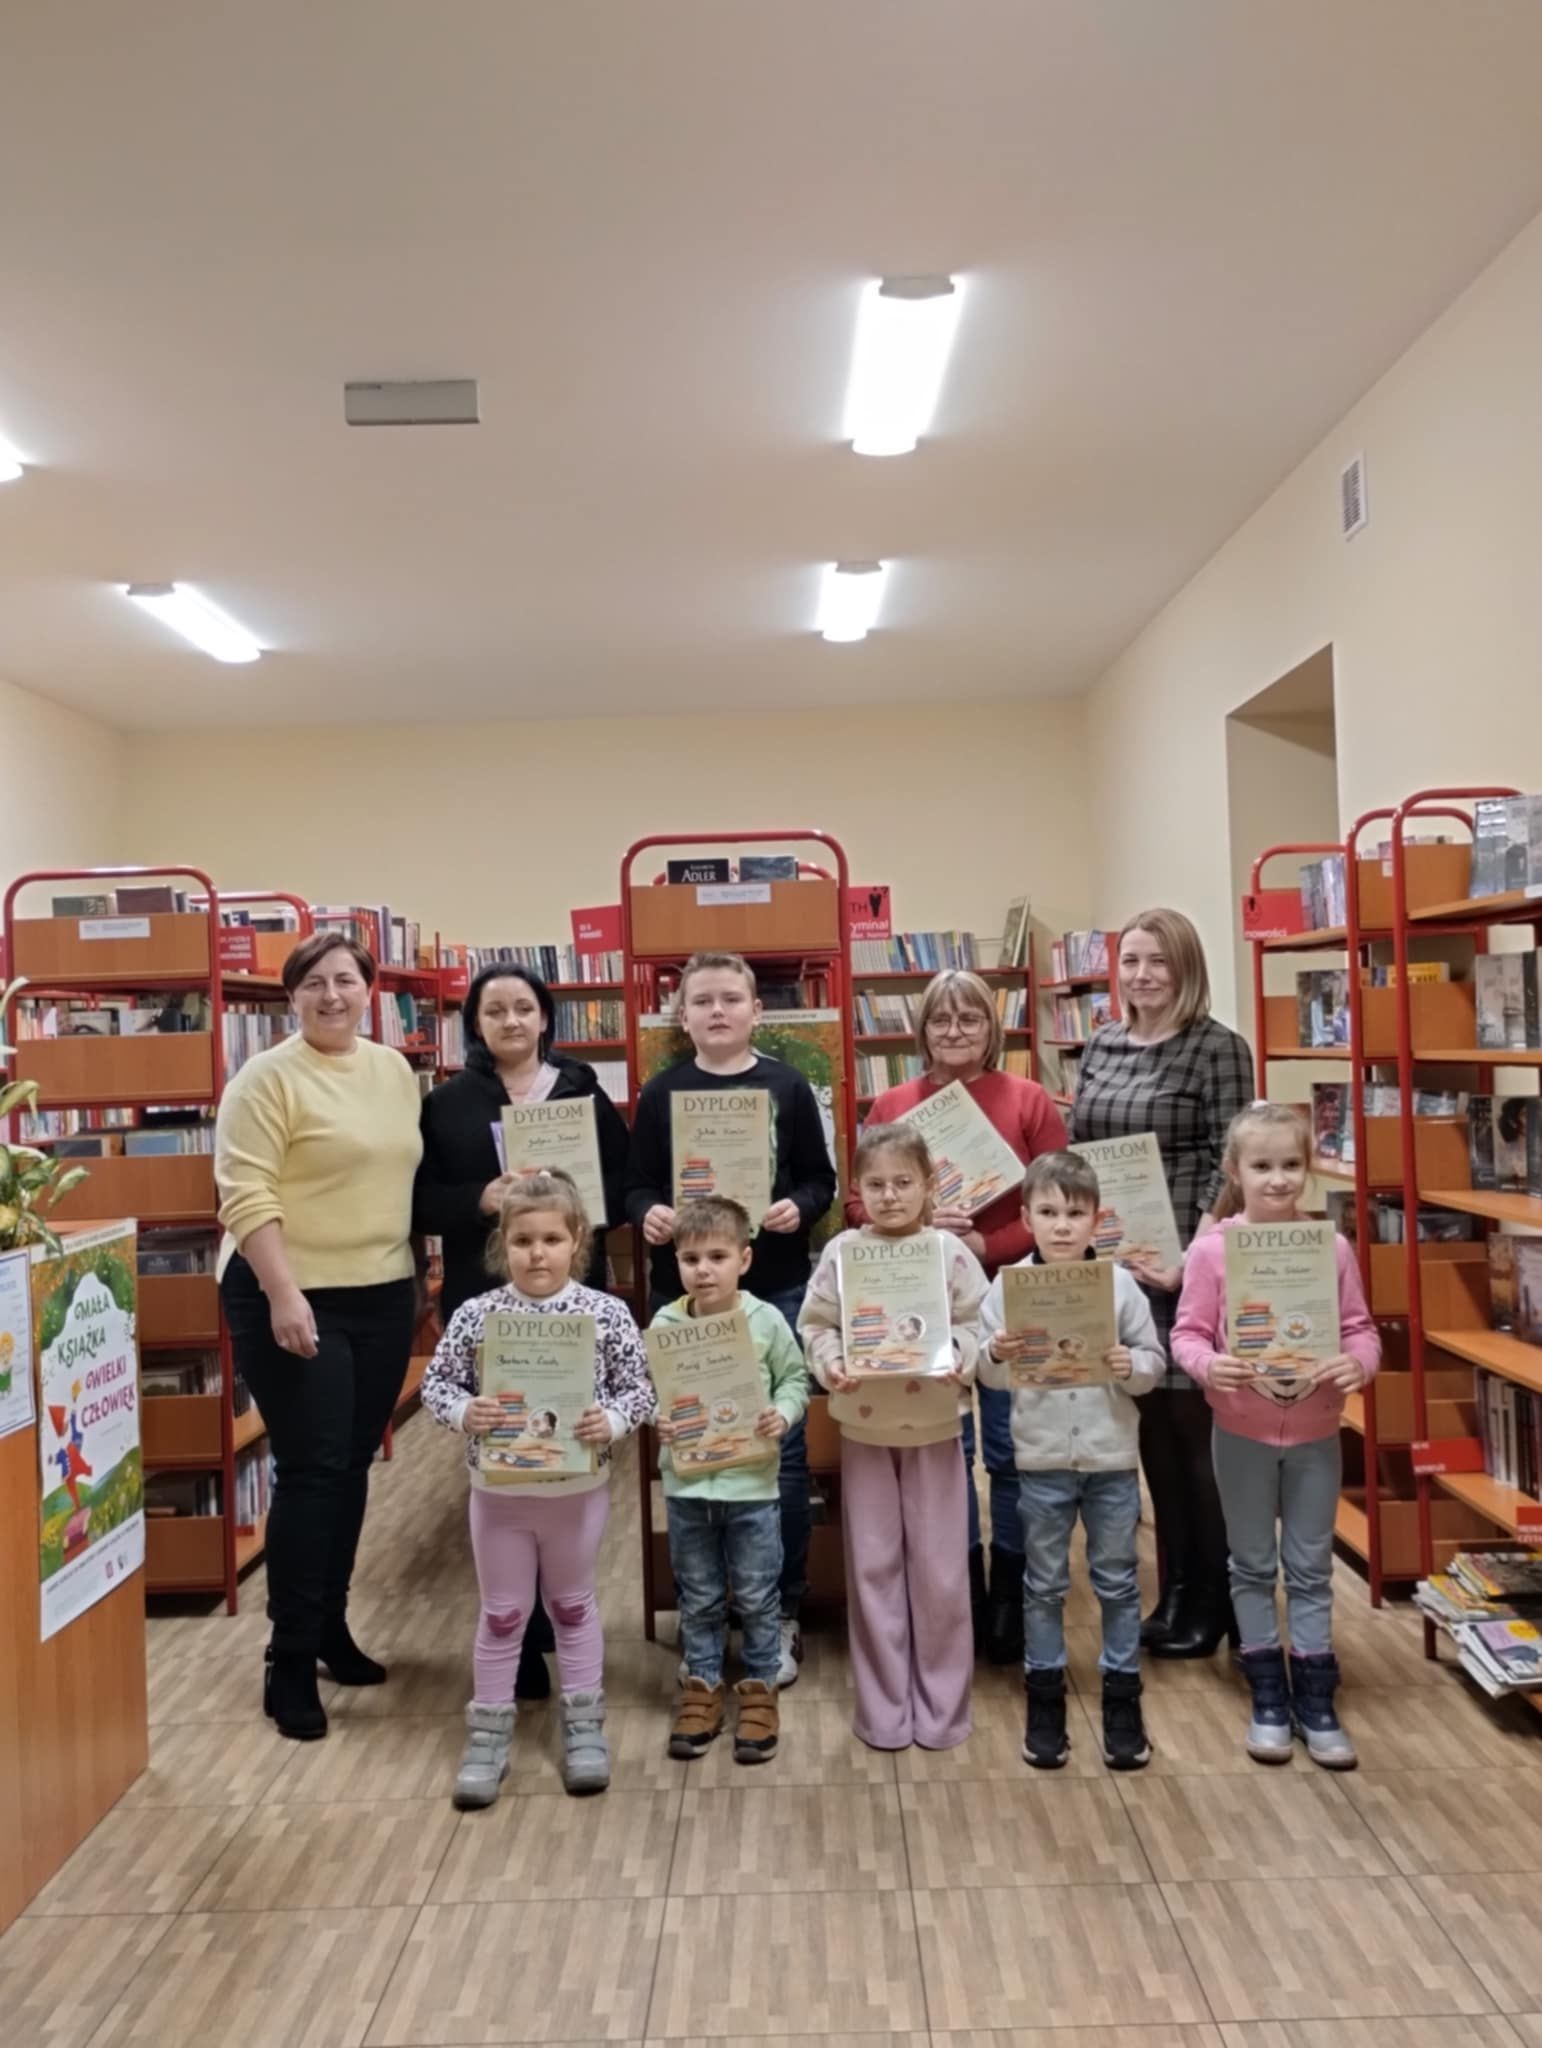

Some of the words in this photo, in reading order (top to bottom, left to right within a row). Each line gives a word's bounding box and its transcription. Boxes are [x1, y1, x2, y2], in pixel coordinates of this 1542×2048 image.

[681, 869, 716, 882] ADLER
[513, 1103, 584, 1125] DYPLOM
[684, 1095, 758, 1113] DYPLOM
[1237, 1229, 1323, 1249] DYPLOM
[852, 1241, 930, 1261] DYPLOM
[1014, 1266, 1101, 1286] DYPLOM
[74, 1291, 110, 1321] MAŁA
[496, 1319, 583, 1338] DYPLOM
[656, 1319, 738, 1350] DYPLOM
[57, 1325, 106, 1369] KSIĄŻKA
[85, 1355, 127, 1390] WIELKI
[81, 1383, 136, 1428] CZŁOWIEK
